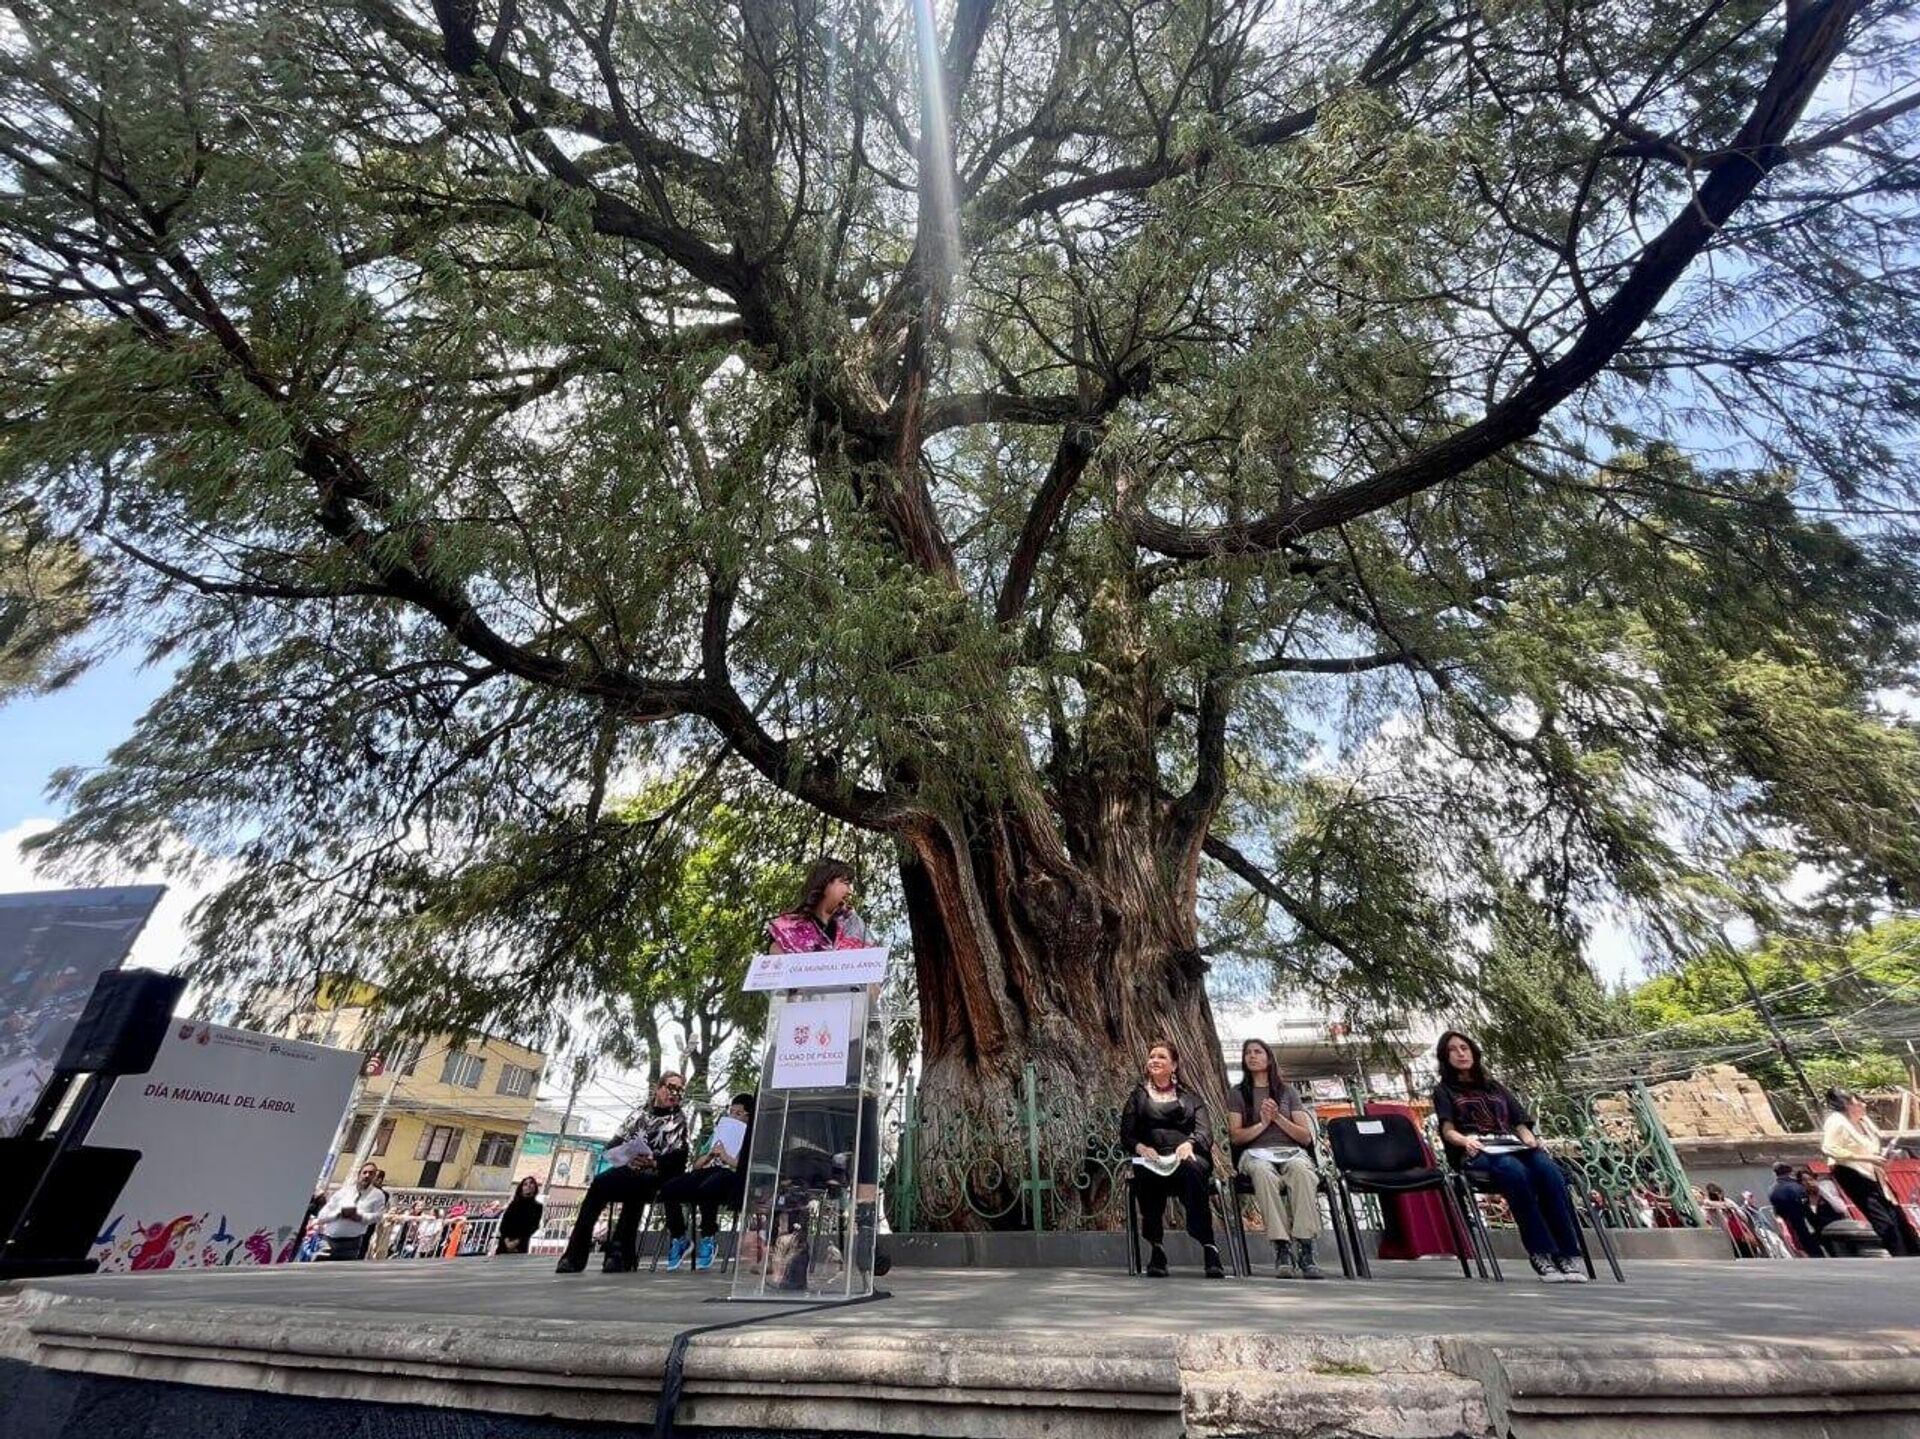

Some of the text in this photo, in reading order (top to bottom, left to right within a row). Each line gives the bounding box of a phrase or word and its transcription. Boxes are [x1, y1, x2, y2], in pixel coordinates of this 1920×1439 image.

[144, 1082, 297, 1113] DÍA MUNDIAL DEL ÁRBOL
